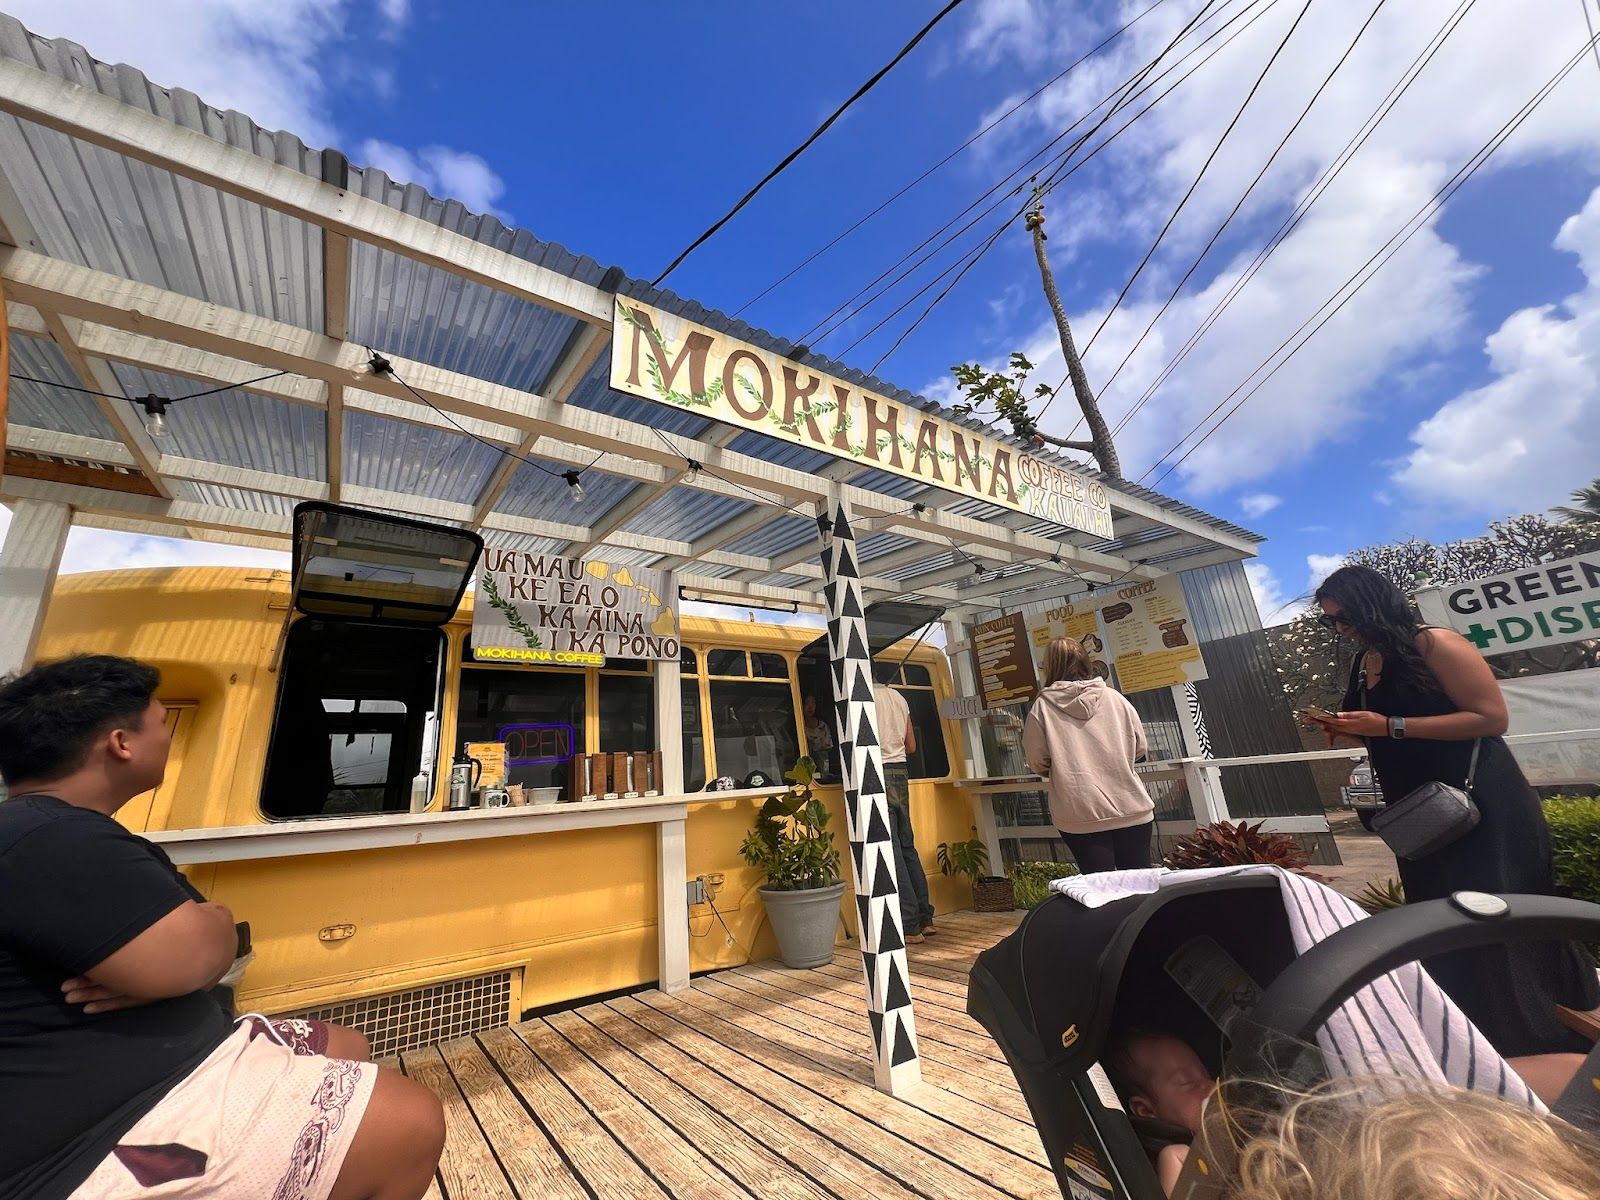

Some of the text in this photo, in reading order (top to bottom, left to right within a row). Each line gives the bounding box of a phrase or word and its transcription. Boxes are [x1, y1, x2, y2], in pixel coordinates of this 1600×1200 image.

[625, 305, 1020, 505] MOKIHANA
[1018, 454, 1106, 510] COFFEE CO
[484, 548, 585, 581] UA MAU
[508, 575, 620, 609] KE EA O
[1117, 580, 1158, 600] COFFEE
[1448, 561, 1600, 615] GREEN
[537, 604, 575, 629] KA
[1046, 604, 1074, 623] FOOD
[476, 646, 604, 666] MOKIHANA COFFEE
[549, 629, 679, 659] I KA PONO
[951, 699, 978, 716] JUICE
[504, 728, 571, 761] OPEN
